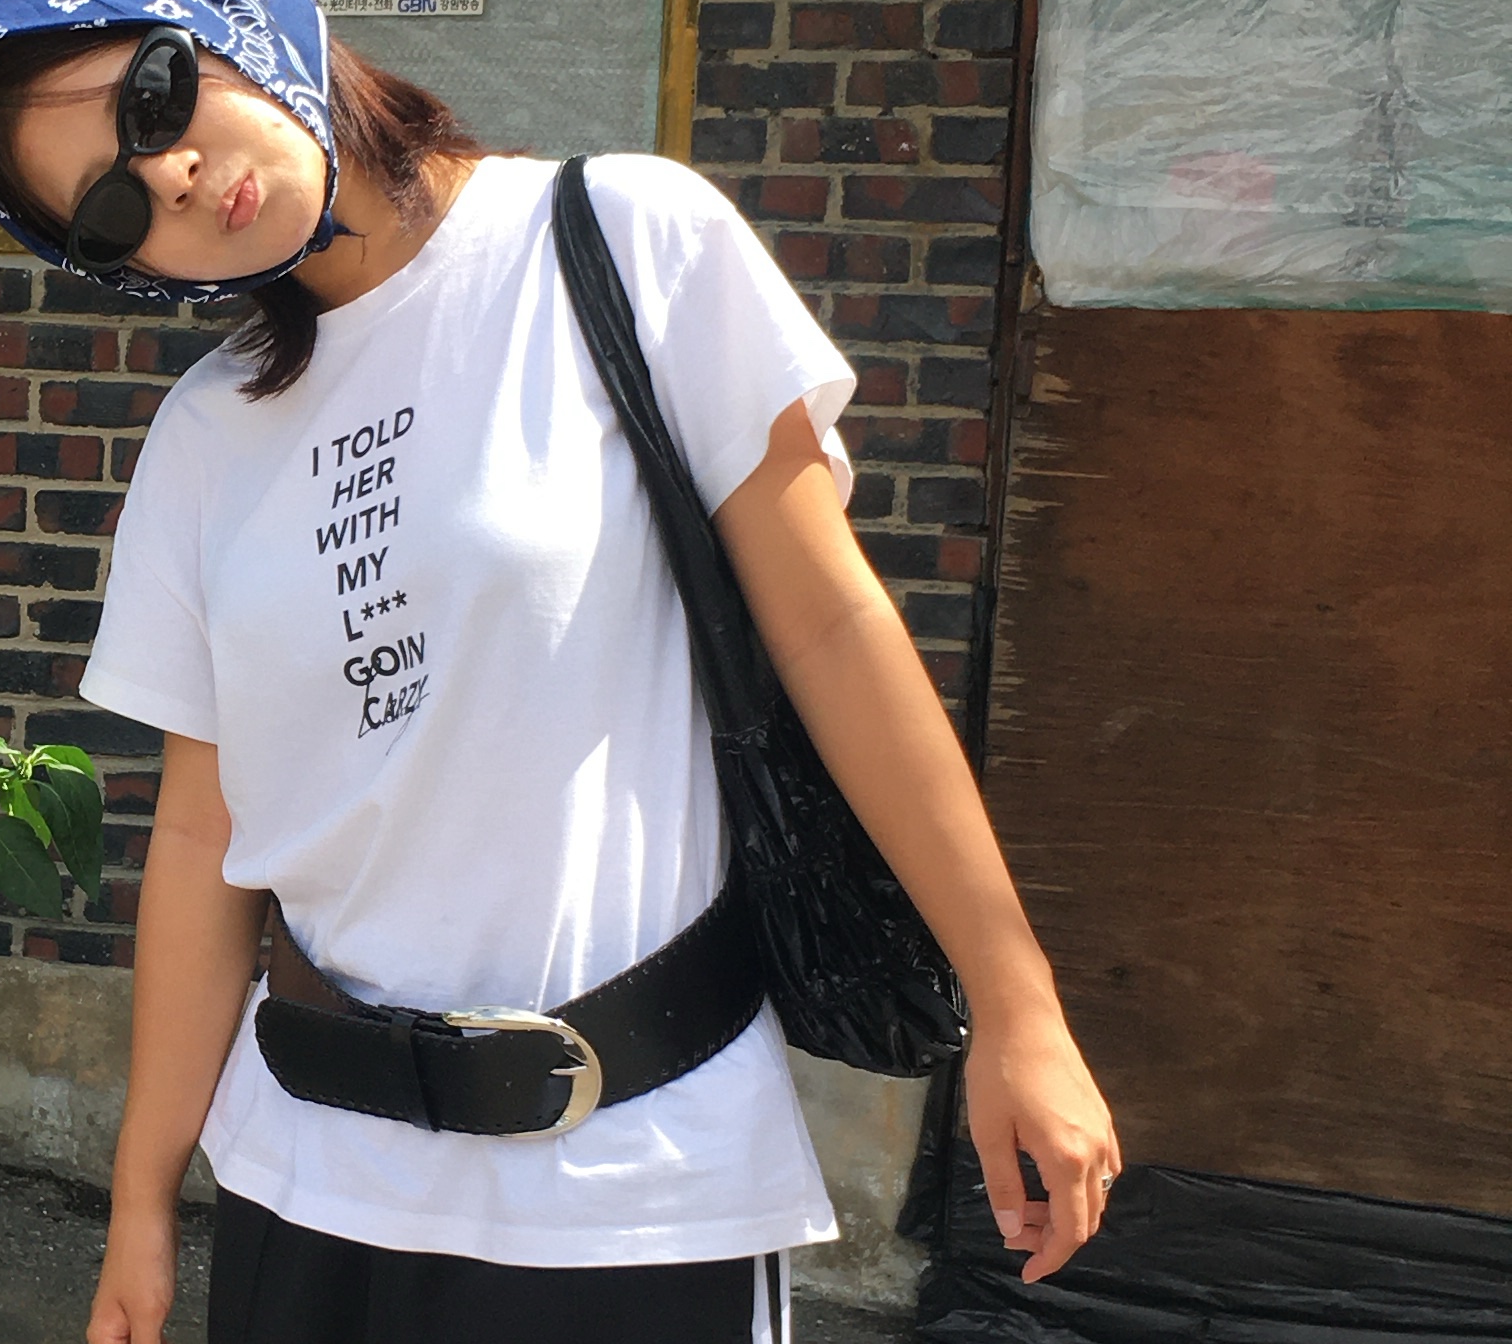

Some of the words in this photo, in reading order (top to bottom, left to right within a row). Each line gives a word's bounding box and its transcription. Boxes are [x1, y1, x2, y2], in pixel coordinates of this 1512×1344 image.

[312, 445, 320, 478] I
[331, 406, 415, 468] TOLD
[331, 456, 396, 509] HER
[315, 495, 401, 555] WITH
[337, 546, 390, 596] MY
[343, 631, 426, 687] GOIN
